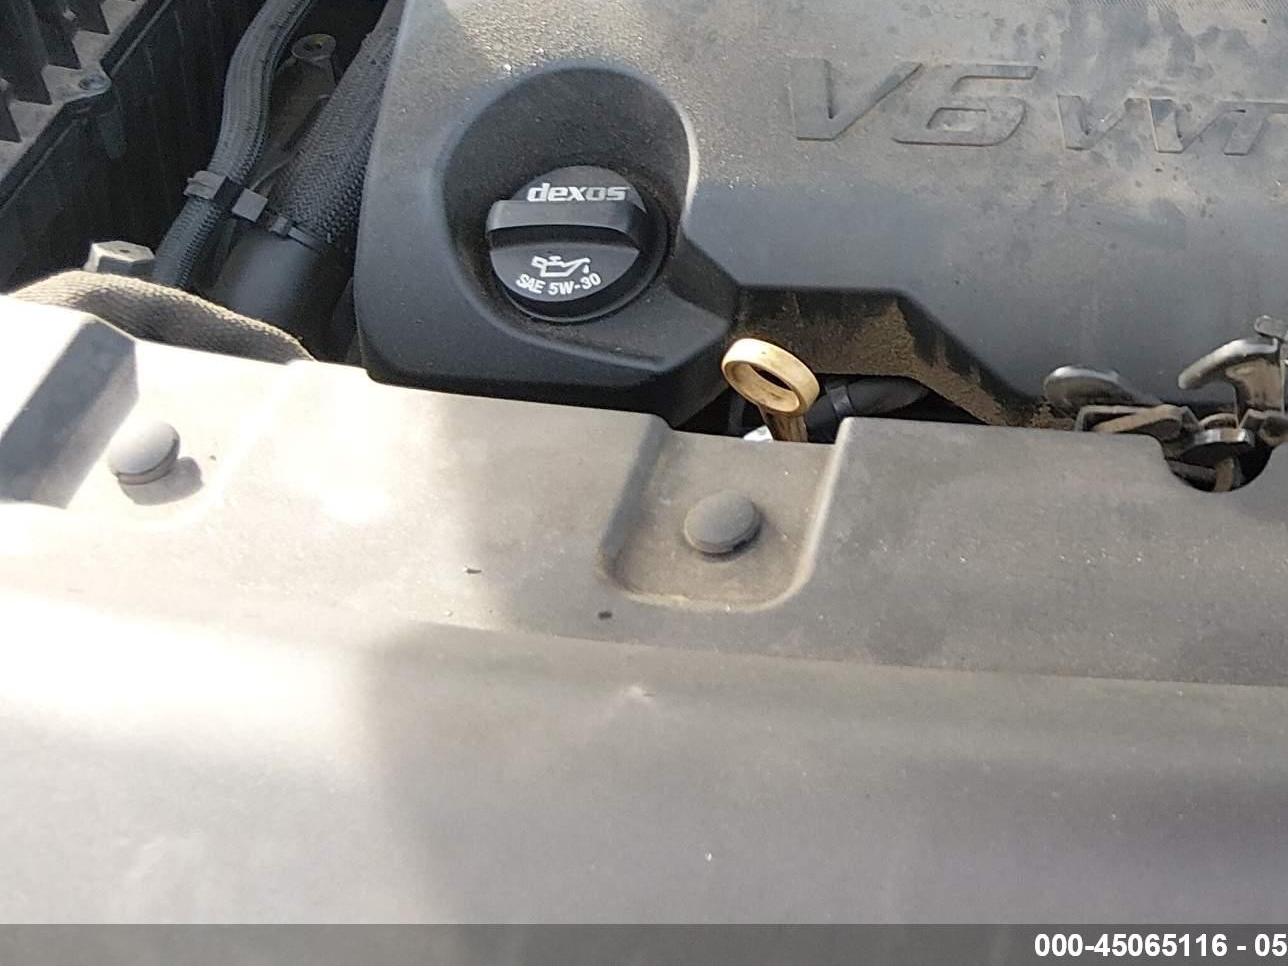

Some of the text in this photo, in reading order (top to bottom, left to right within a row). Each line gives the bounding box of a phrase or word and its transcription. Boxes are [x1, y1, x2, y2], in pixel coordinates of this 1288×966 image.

[787, 57, 1038, 148] V6
[526, 182, 630, 203] dexos
[516, 274, 602, 295] SAE 5W-30
